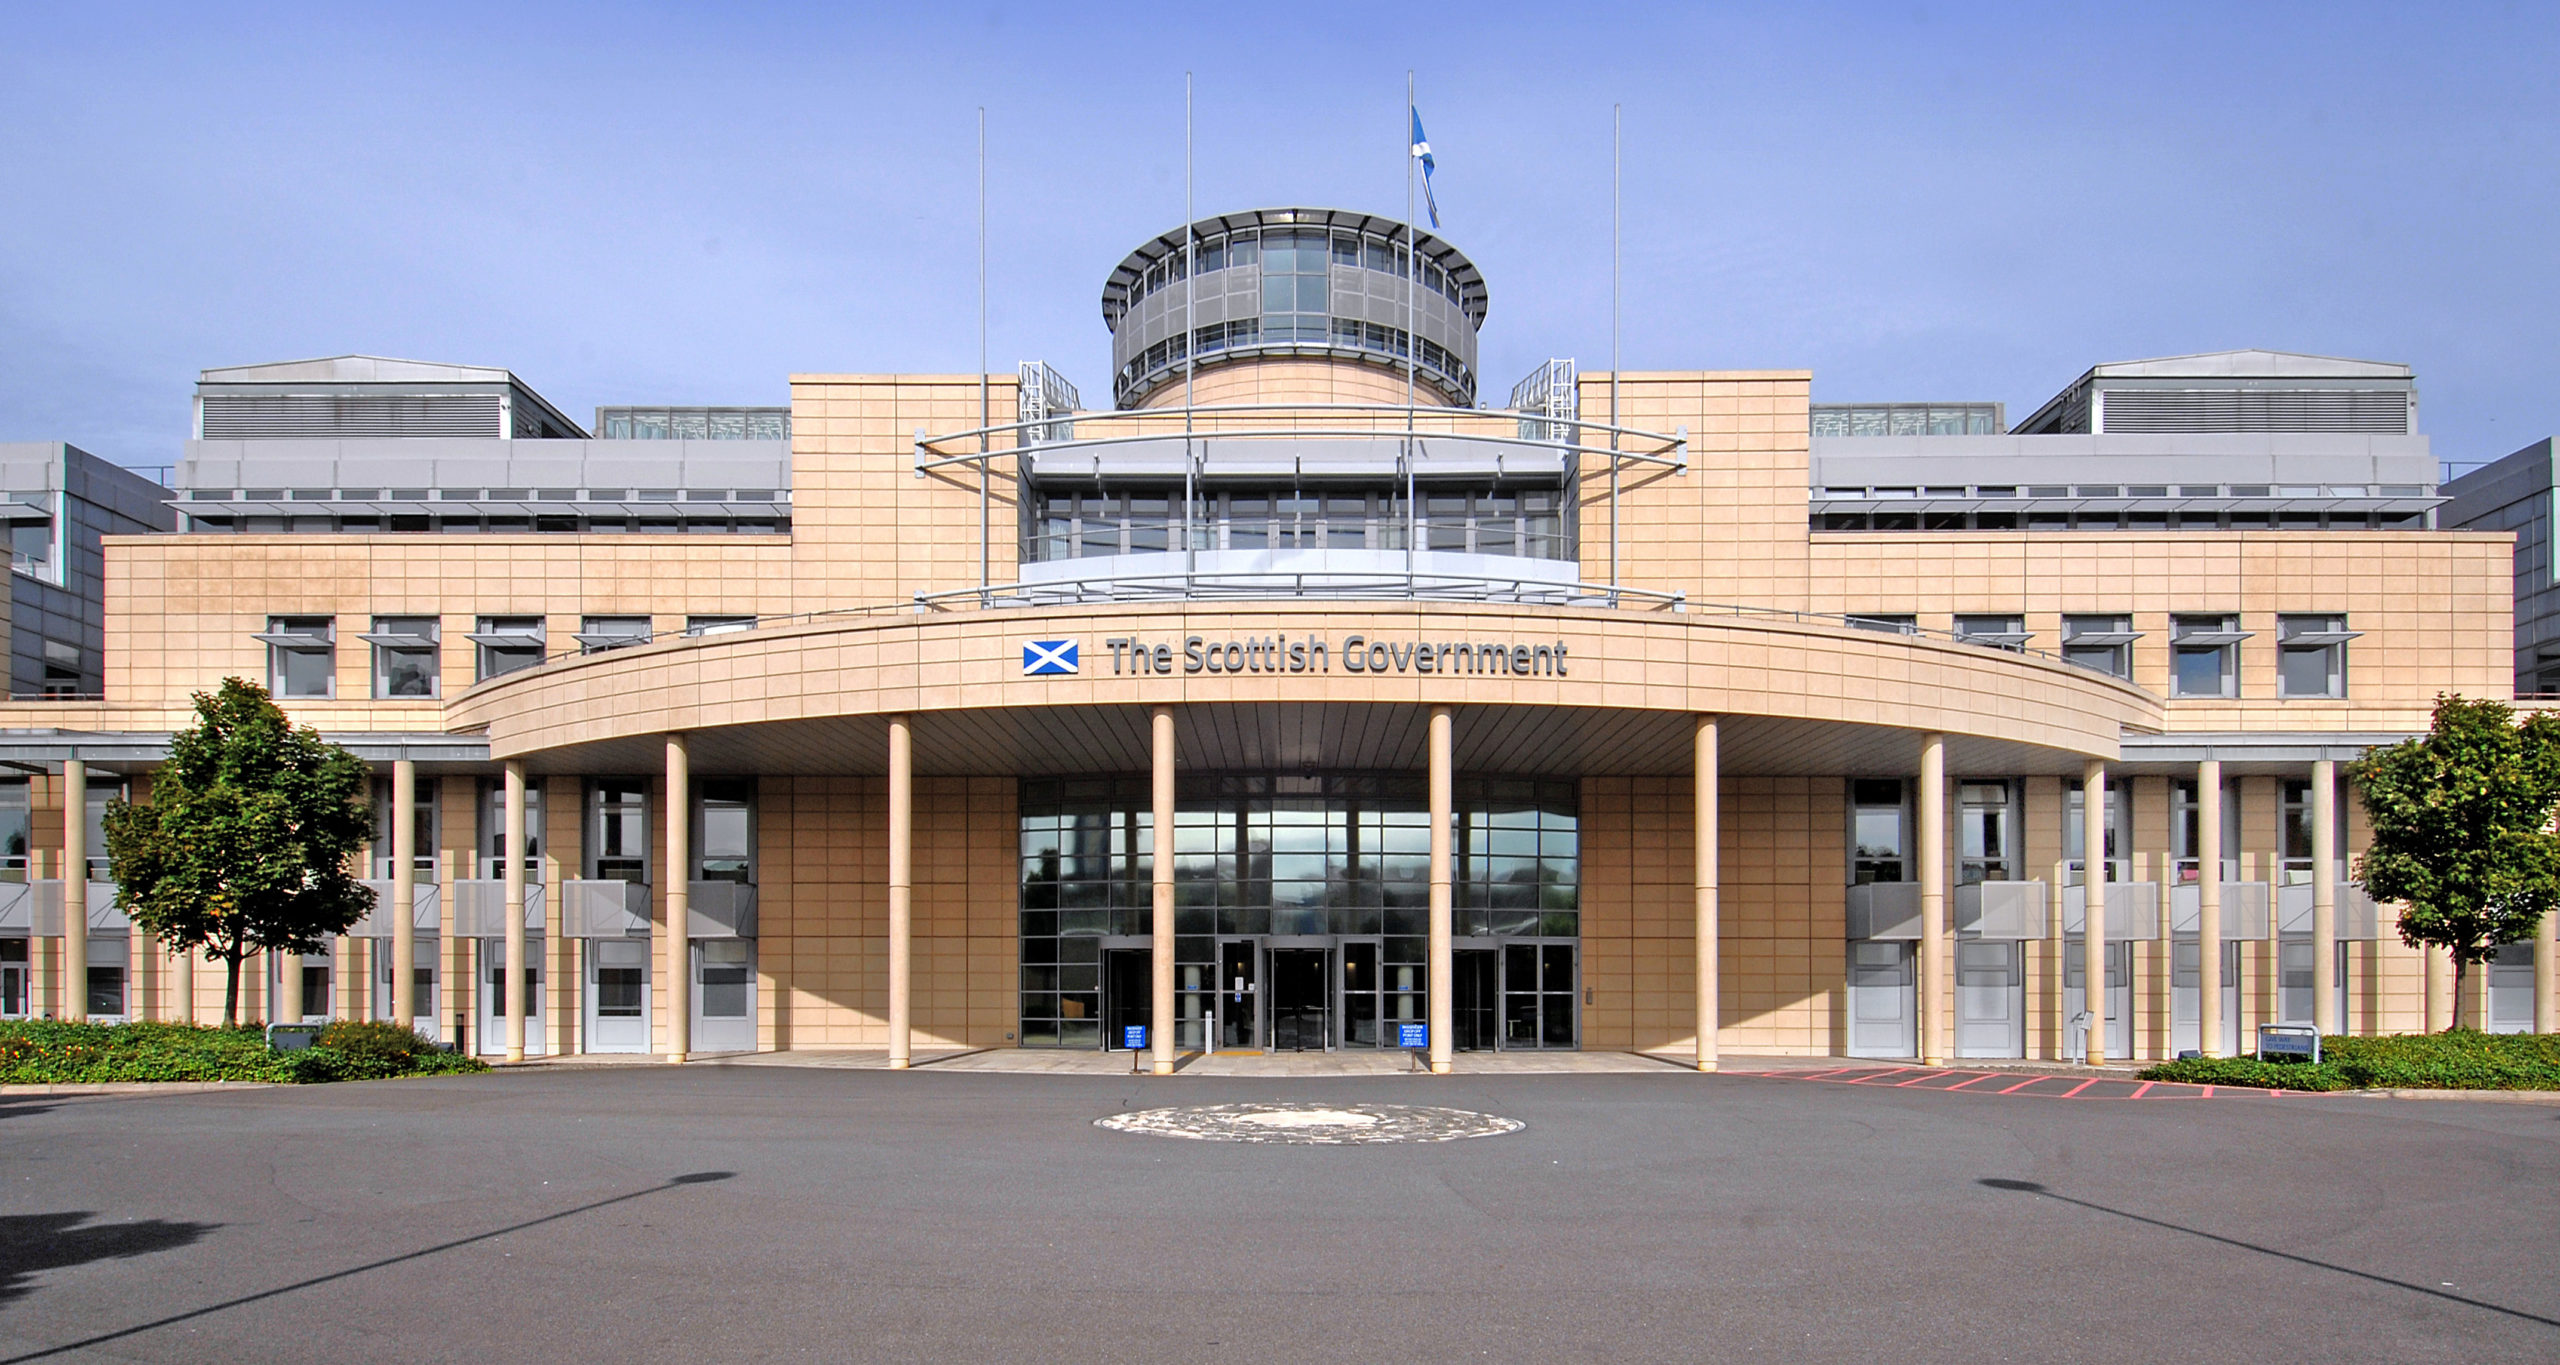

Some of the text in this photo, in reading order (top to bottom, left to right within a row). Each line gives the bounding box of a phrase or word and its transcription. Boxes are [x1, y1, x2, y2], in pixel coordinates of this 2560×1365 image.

[1106, 634, 1568, 677] The Scottish Government
